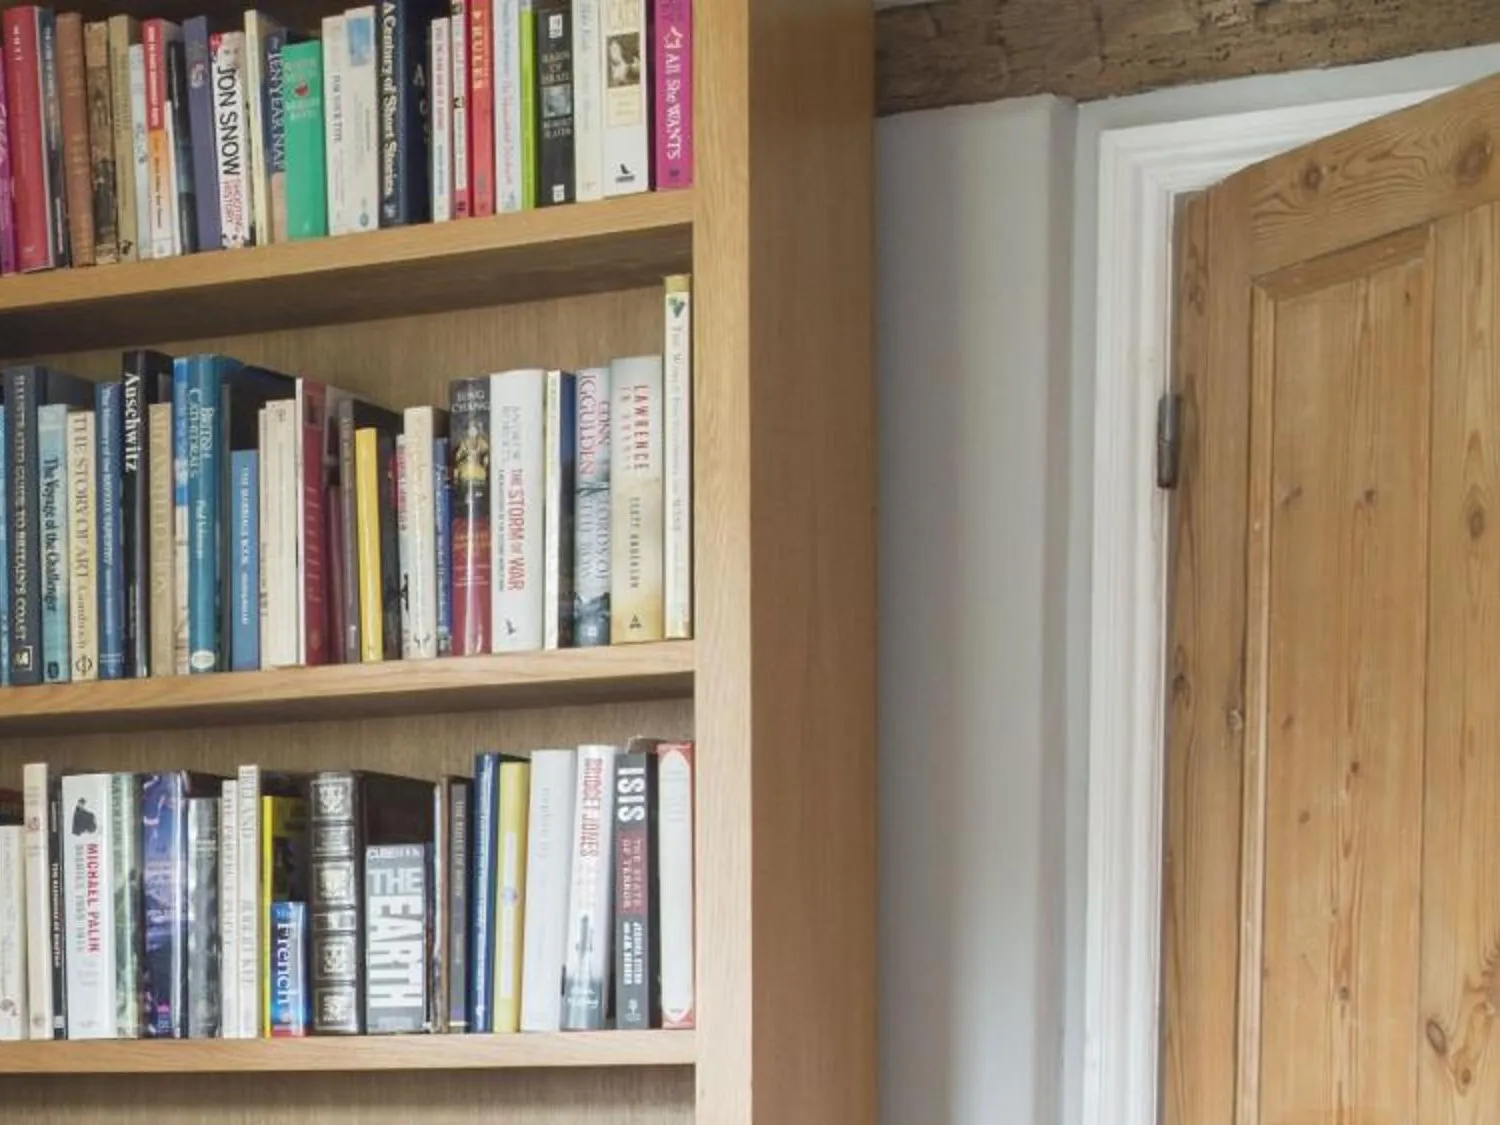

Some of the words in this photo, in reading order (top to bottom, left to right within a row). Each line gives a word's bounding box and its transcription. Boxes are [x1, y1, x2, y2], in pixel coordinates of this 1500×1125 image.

[381, 17, 396, 76] Century
[665, 53, 681, 75] All
[215, 66, 237, 107] JON
[383, 78, 397, 92] of
[665, 79, 681, 103] She
[384, 96, 397, 138] Short
[666, 105, 682, 160] WANTS
[217, 111, 241, 176] SNOW
[384, 142, 397, 195] Stories
[73, 414, 87, 452] THE
[124, 373, 140, 473] Auschwitz
[579, 371, 597, 476] IGGULDEN
[633, 384, 649, 471] LAWRENCE
[43, 459, 59, 478] The
[73, 459, 88, 515] STORY
[510, 468, 523, 487] THE
[42, 480, 59, 517] Voyage
[507, 489, 524, 541] STORM
[44, 532, 59, 549] the
[74, 519, 88, 541] OF
[42, 551, 59, 613] Challenger
[74, 544, 88, 578] ART
[507, 557, 524, 591] WAR
[583, 758, 602, 811] BRIDGET
[617, 766, 645, 823] ISIS
[580, 813, 601, 858] JONES
[86, 843, 100, 907] MICHAEL
[369, 866, 422, 894] THE
[86, 911, 101, 953] PALIN
[369, 895, 423, 1008] EARTH
[277, 922, 297, 1005] French
